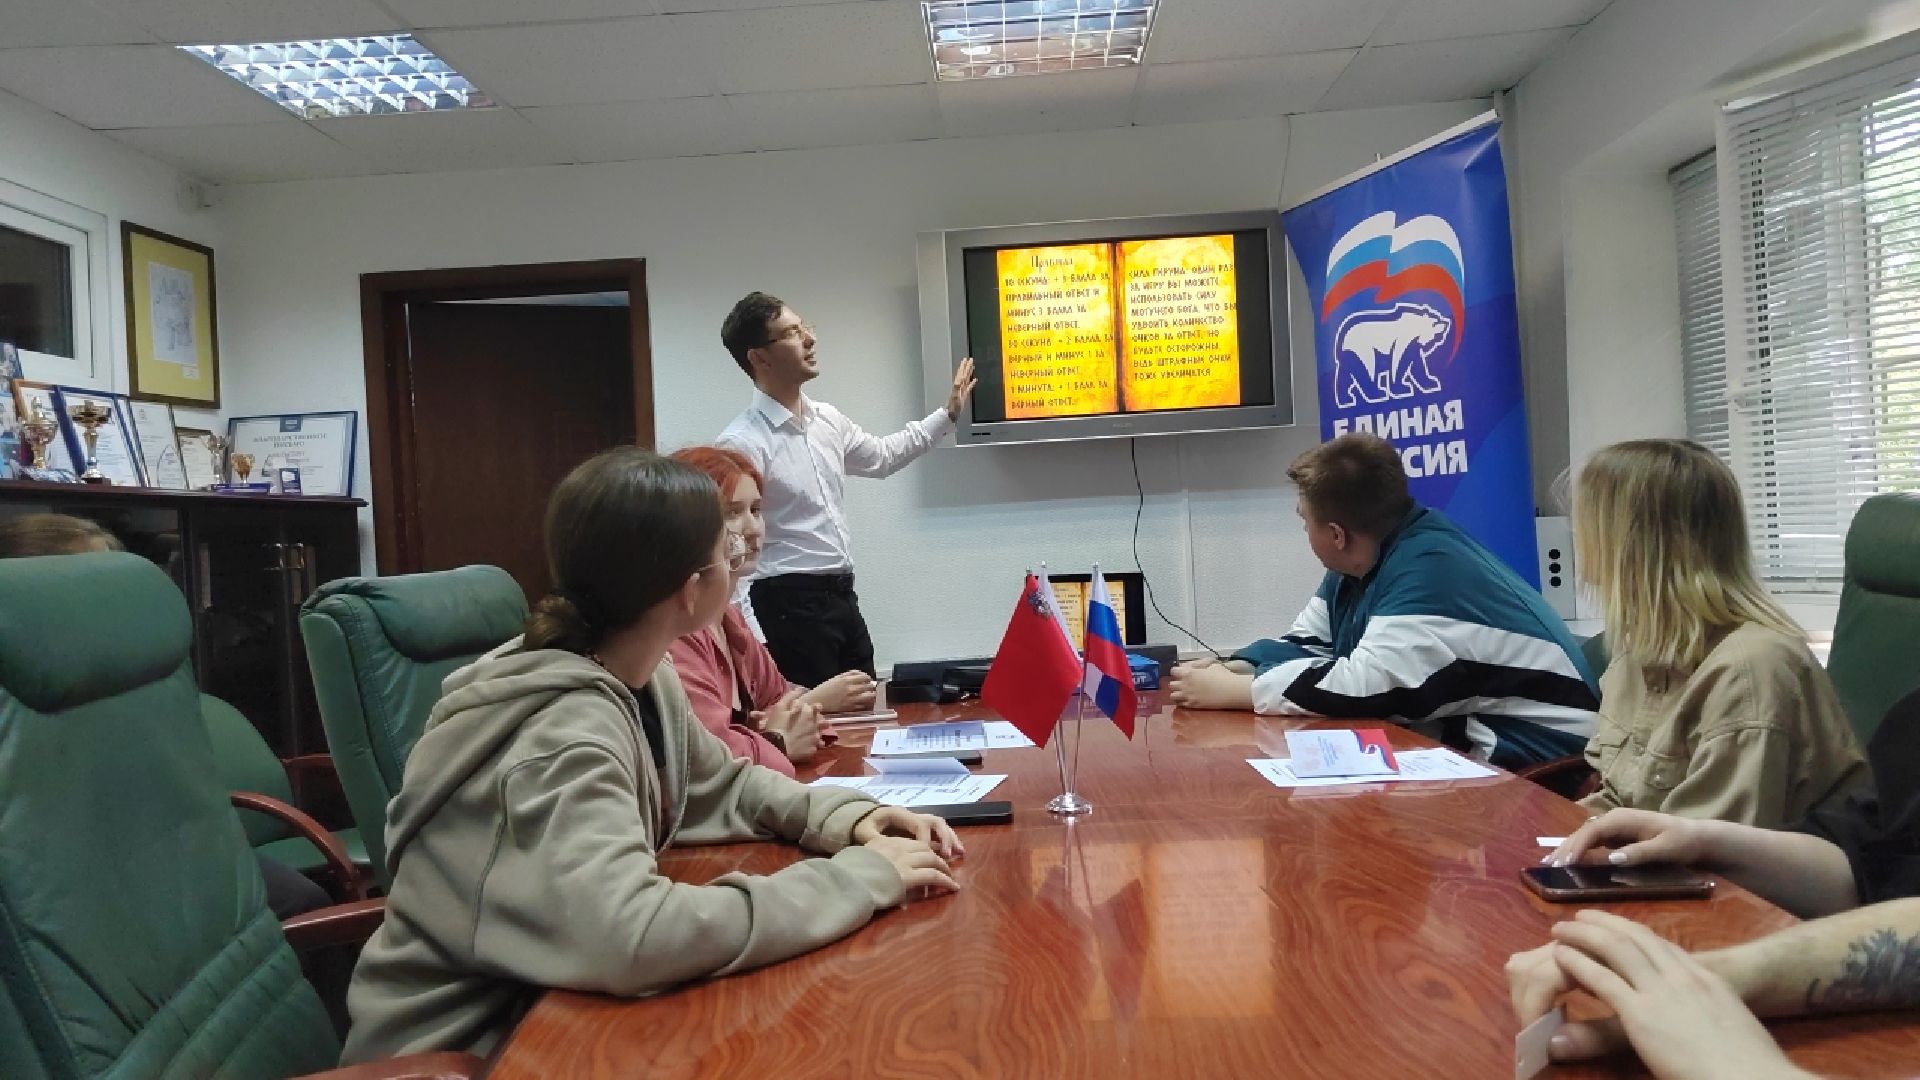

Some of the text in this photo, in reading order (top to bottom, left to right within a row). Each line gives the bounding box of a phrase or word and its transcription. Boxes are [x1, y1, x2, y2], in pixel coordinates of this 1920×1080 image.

[1167, 279, 1181, 289] ВЫ
[1184, 277, 1219, 287] МОЖЕТЕ
[1005, 288, 1063, 302] ПРАВИЛЬНЫЙ
[1065, 288, 1090, 298] ОТВЕТ
[1130, 292, 1192, 304] ИСПОЛЬЗОВАТЬ
[1007, 307, 1036, 317] МИНУС
[1131, 306, 1174, 316] МОГУЧЕГО
[1203, 303, 1220, 313] ЧТО
[1007, 319, 1051, 333] НЕВЕРНЫЙ
[1131, 316, 1225, 330] УДВОИТЬ КОЛИЧЕСТВО
[1008, 351, 1043, 363] ВЕРНЫЙ
[1055, 351, 1085, 361] МИНУС
[1010, 366, 1054, 380] НЕВЕРНЫЙ
[1011, 397, 1045, 410] ВЕРНЫЙ
[1333, 399, 1465, 440] ЕДИНАЯ
[1397, 439, 1468, 478] СИЯ
